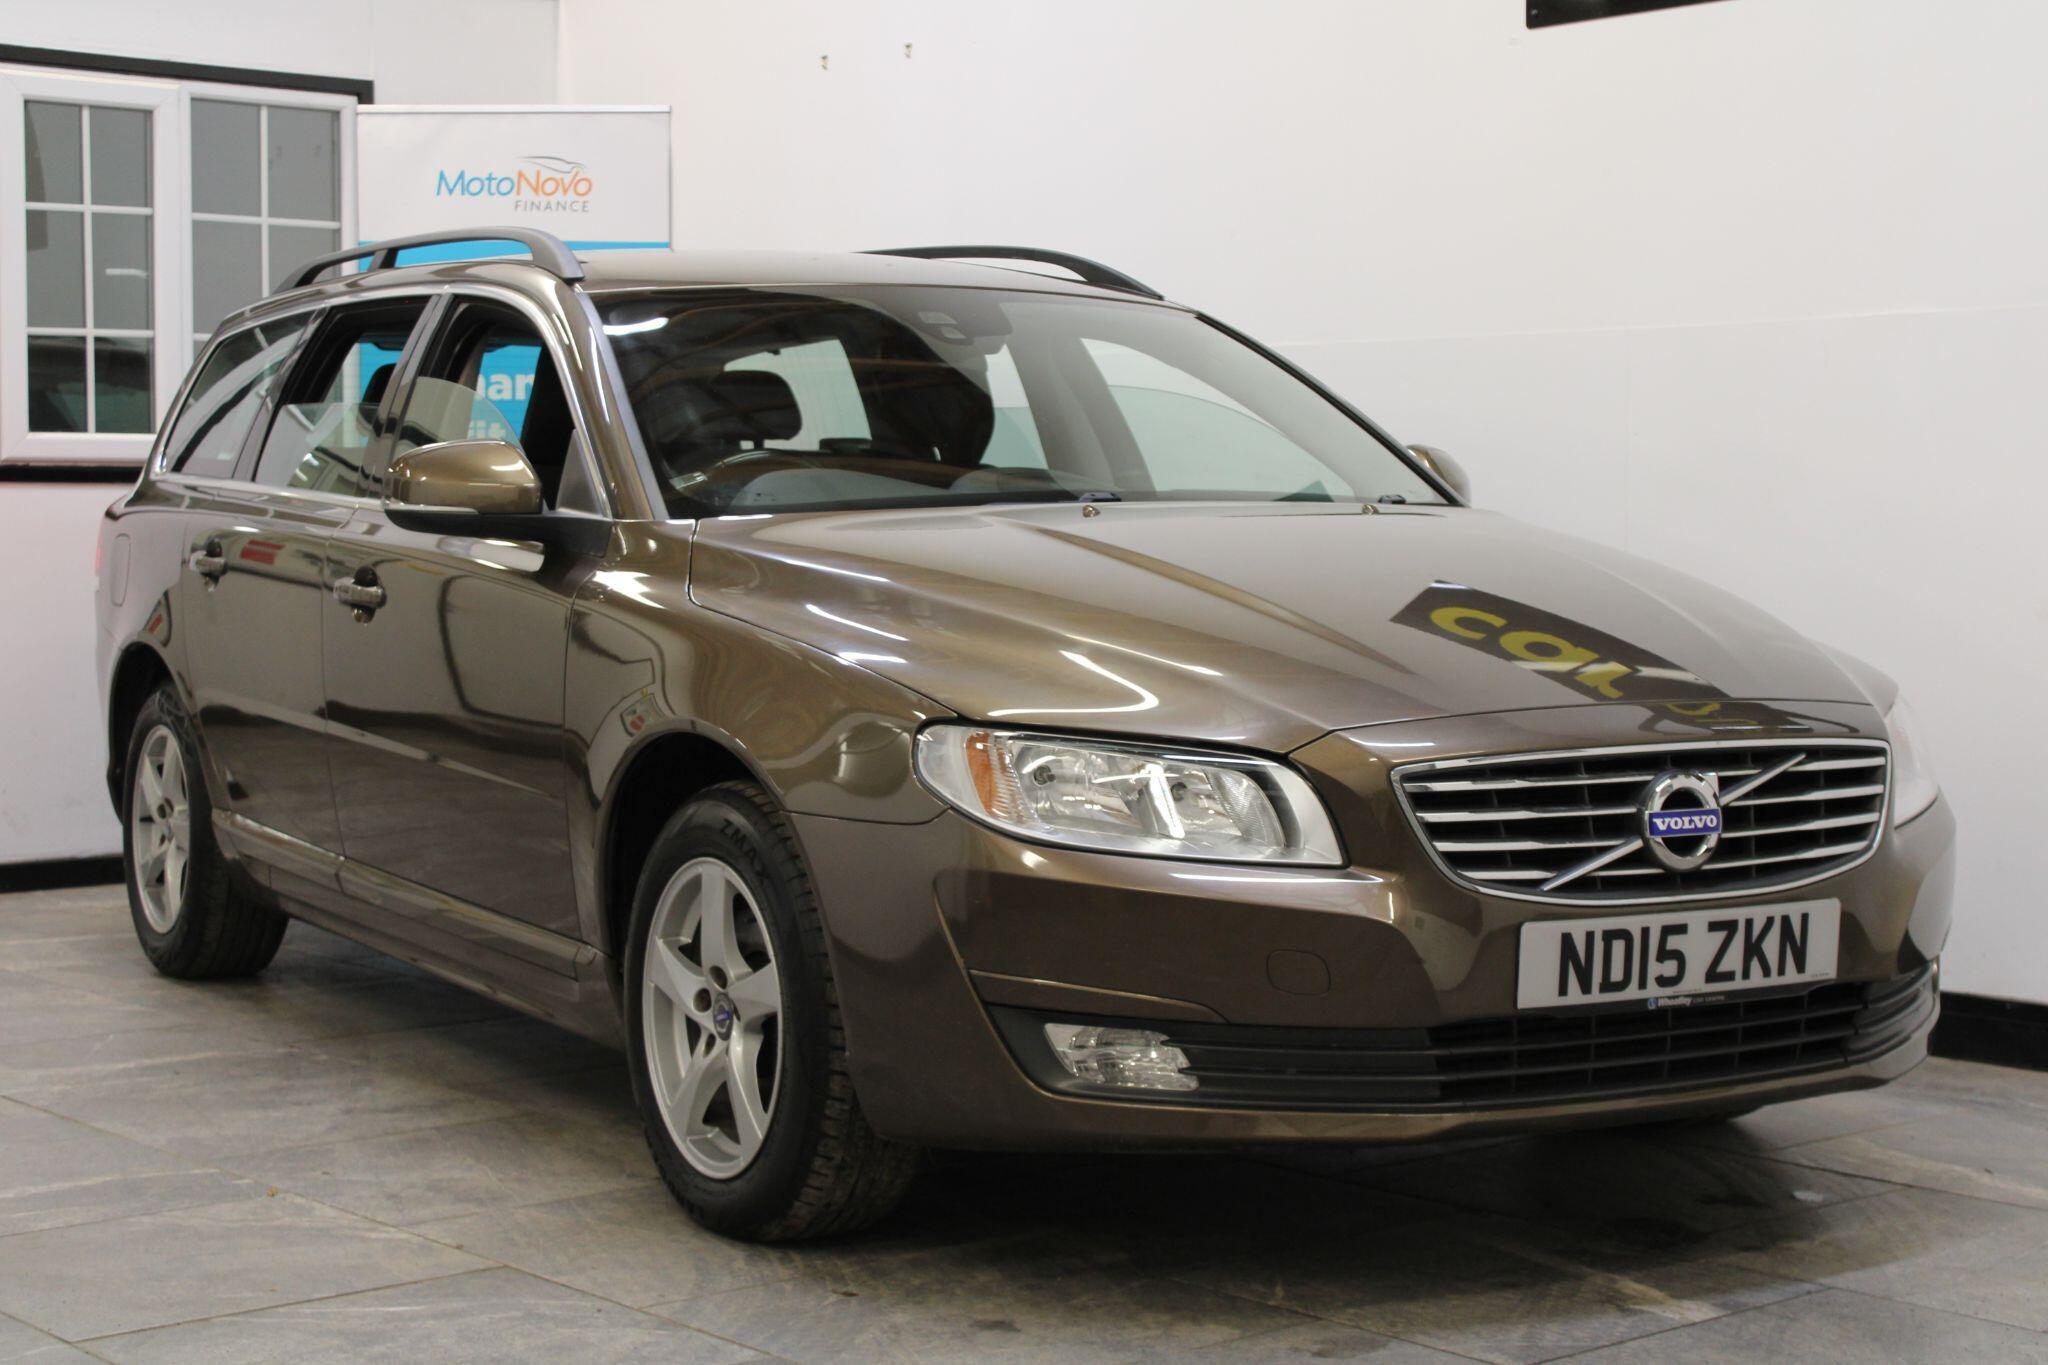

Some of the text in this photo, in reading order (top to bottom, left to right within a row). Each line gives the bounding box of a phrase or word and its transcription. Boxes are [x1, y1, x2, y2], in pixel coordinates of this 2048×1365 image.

[436, 169, 593, 197] MotoNovo
[514, 200, 590, 213] FINANCE
[1652, 815, 1718, 831] VOLVO
[1558, 912, 1810, 997] ND15 ZKN
